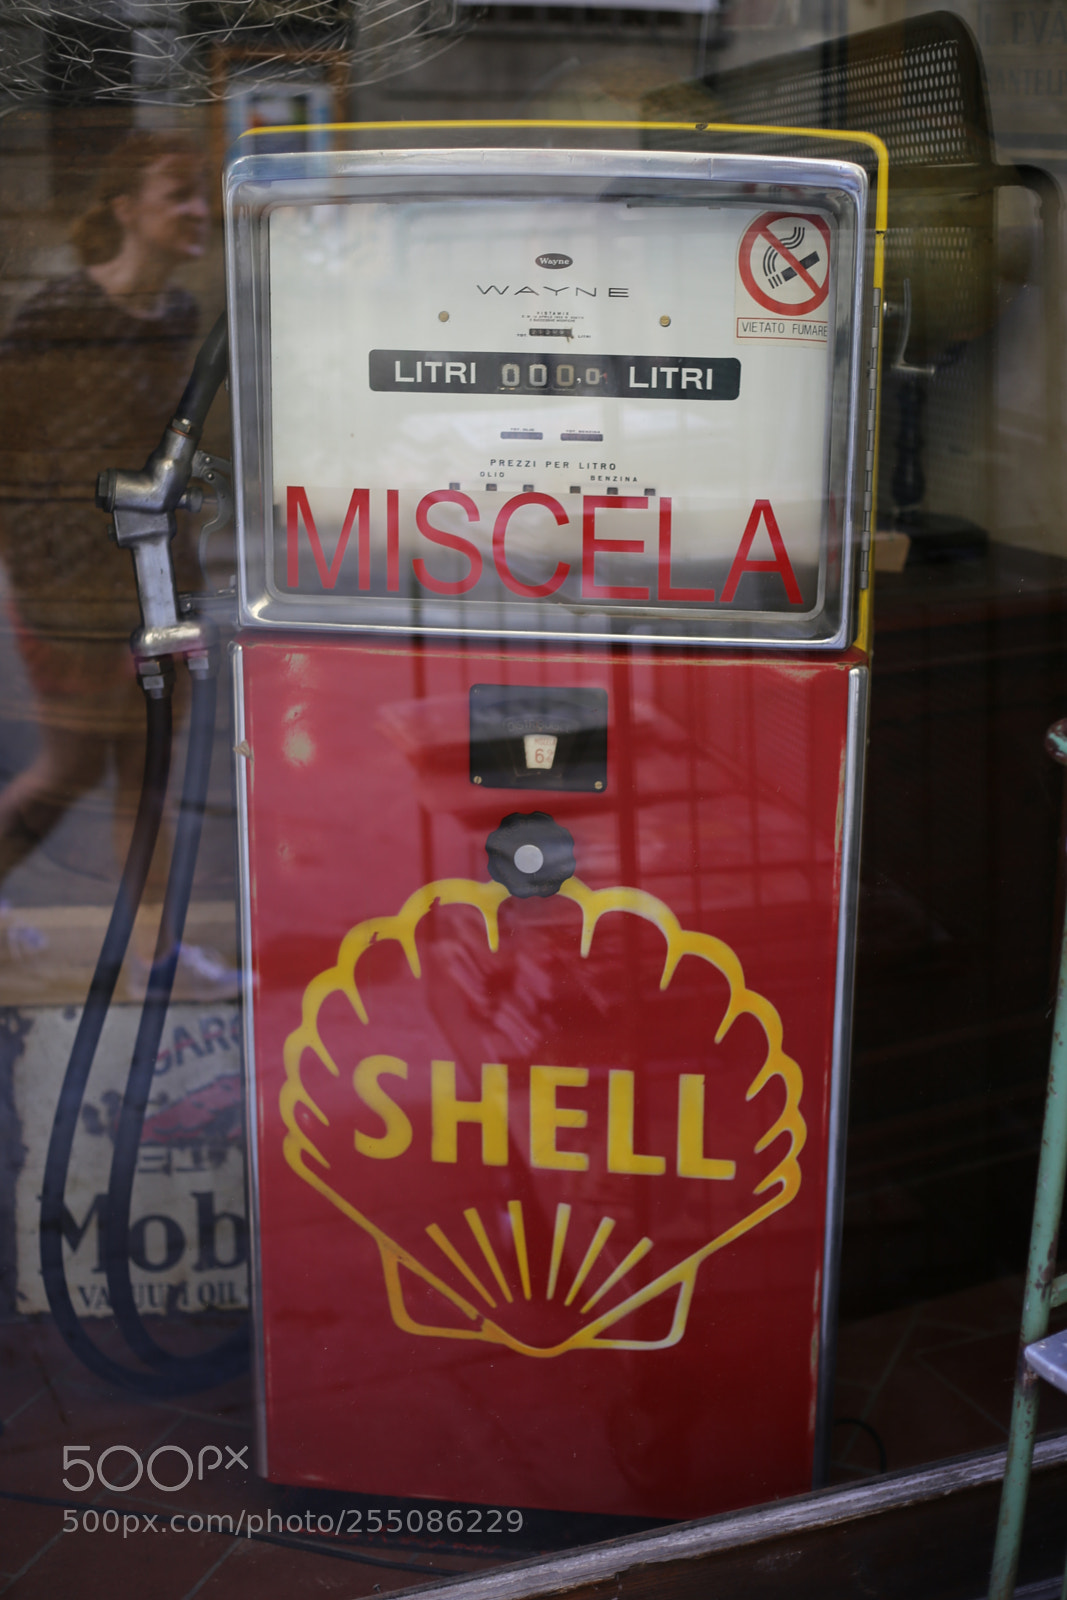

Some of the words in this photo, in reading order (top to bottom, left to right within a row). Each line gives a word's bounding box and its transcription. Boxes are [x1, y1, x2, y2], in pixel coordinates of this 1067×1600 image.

[539, 257, 570, 266] Wayne
[477, 285, 629, 298] WAYNE
[742, 321, 785, 334] VIETATO
[792, 323, 828, 337] FUMARE
[394, 360, 477, 385] LITRI
[629, 366, 713, 391] LITRI
[490, 459, 536, 468] PREZZI
[545, 461, 570, 469] PER
[579, 463, 616, 471] LITRO
[286, 486, 803, 605] MISCELA
[352, 1054, 736, 1180] SHELL
